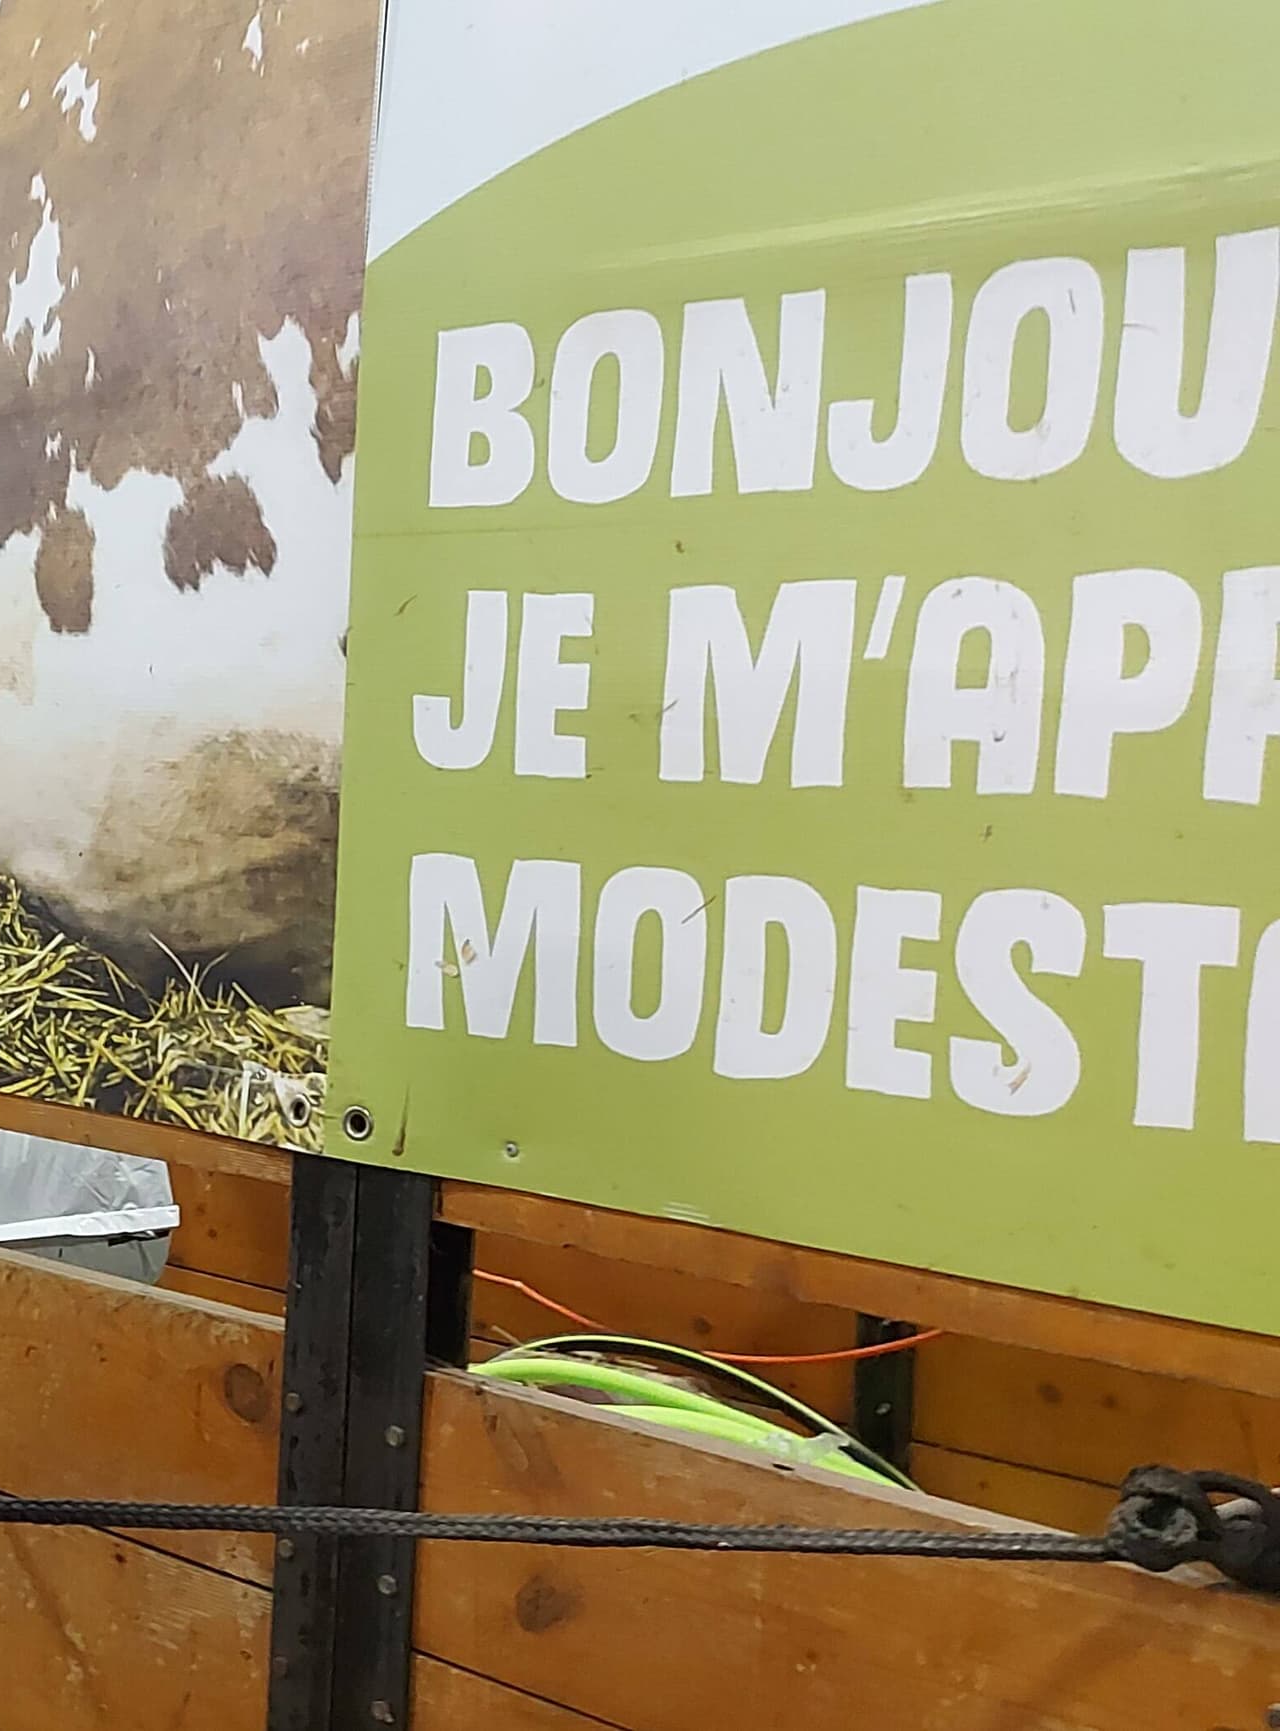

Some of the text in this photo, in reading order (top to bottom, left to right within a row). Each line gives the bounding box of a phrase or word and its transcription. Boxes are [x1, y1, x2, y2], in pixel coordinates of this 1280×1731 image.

[429, 226, 1280, 507] BONJOU
[412, 590, 594, 778] JE
[406, 853, 1280, 1144] MODEST
